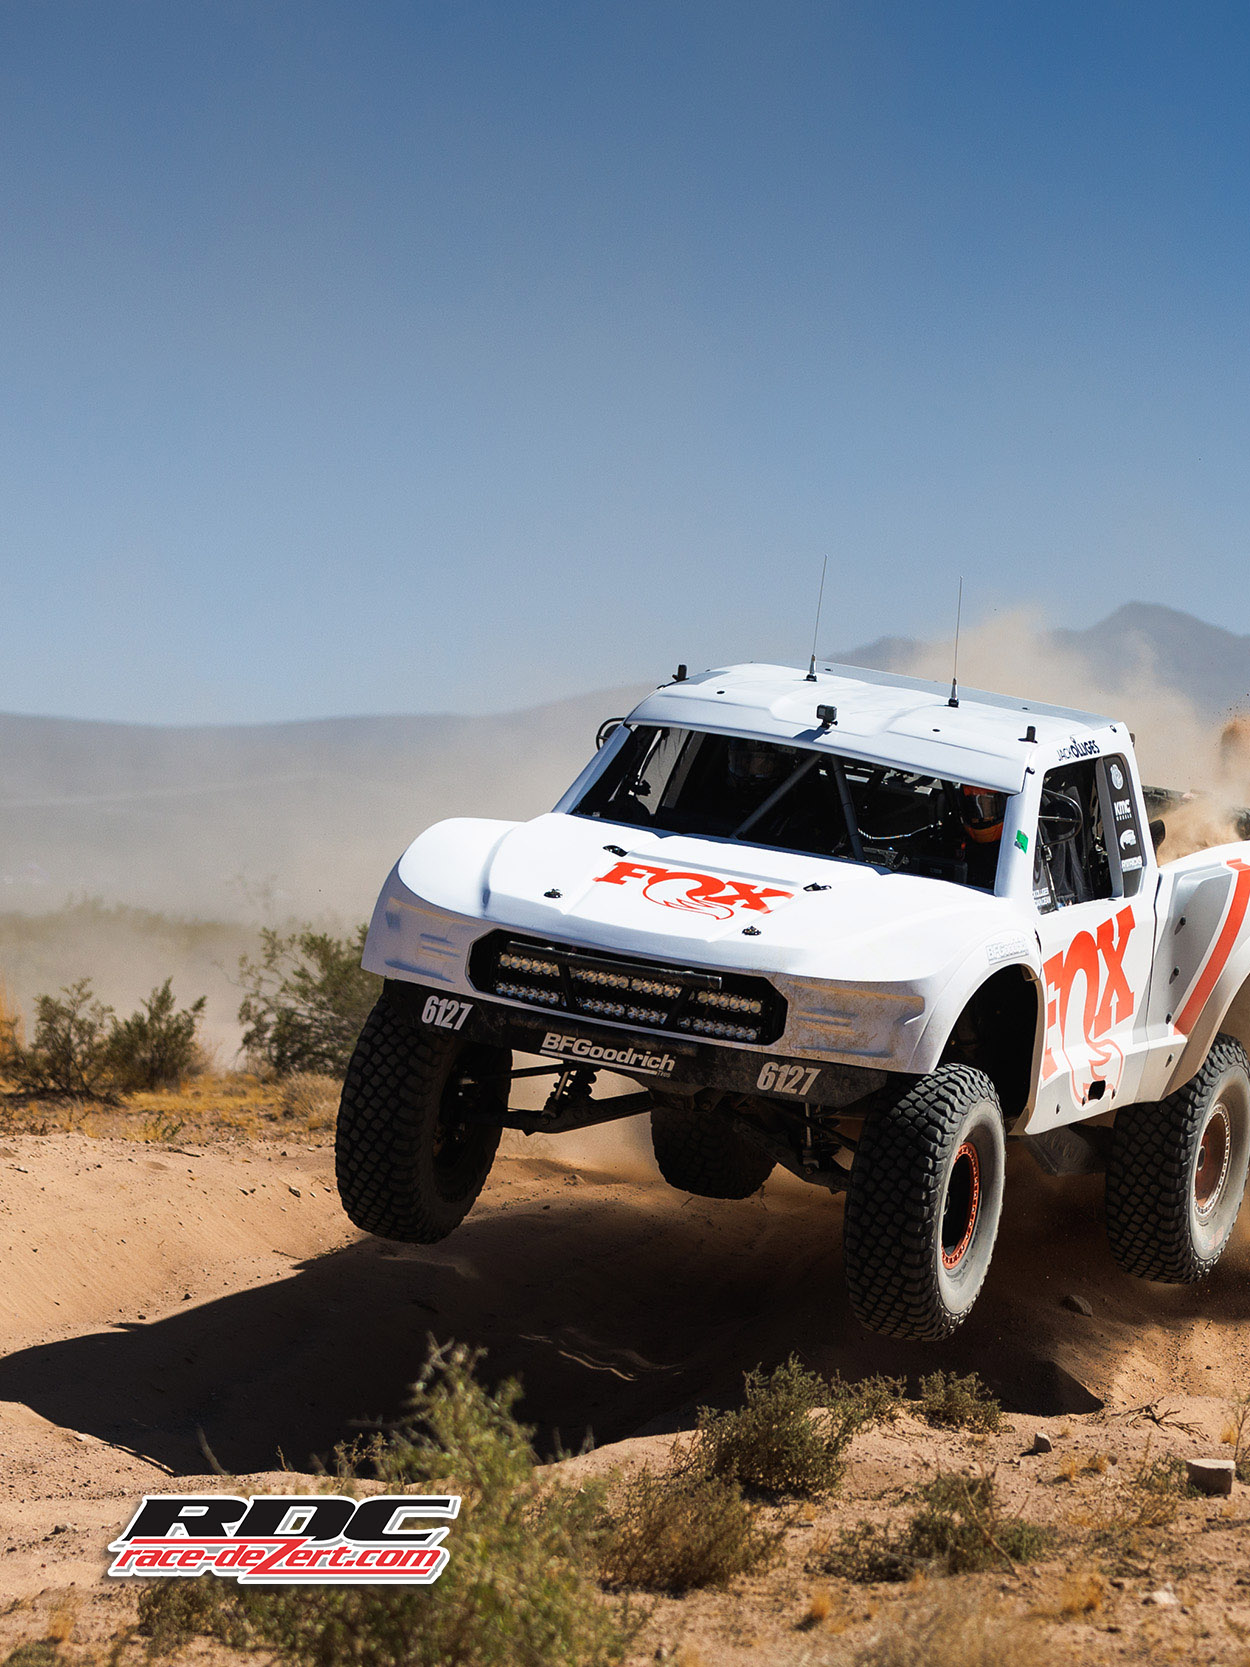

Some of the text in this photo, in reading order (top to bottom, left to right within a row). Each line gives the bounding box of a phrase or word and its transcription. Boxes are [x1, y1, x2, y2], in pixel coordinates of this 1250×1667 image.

[592, 861, 794, 920] FOX
[421, 995, 474, 1031] 6127
[1041, 904, 1136, 1102] FOX
[541, 1032, 676, 1072] BFGoodrich
[756, 1061, 822, 1096] 6127
